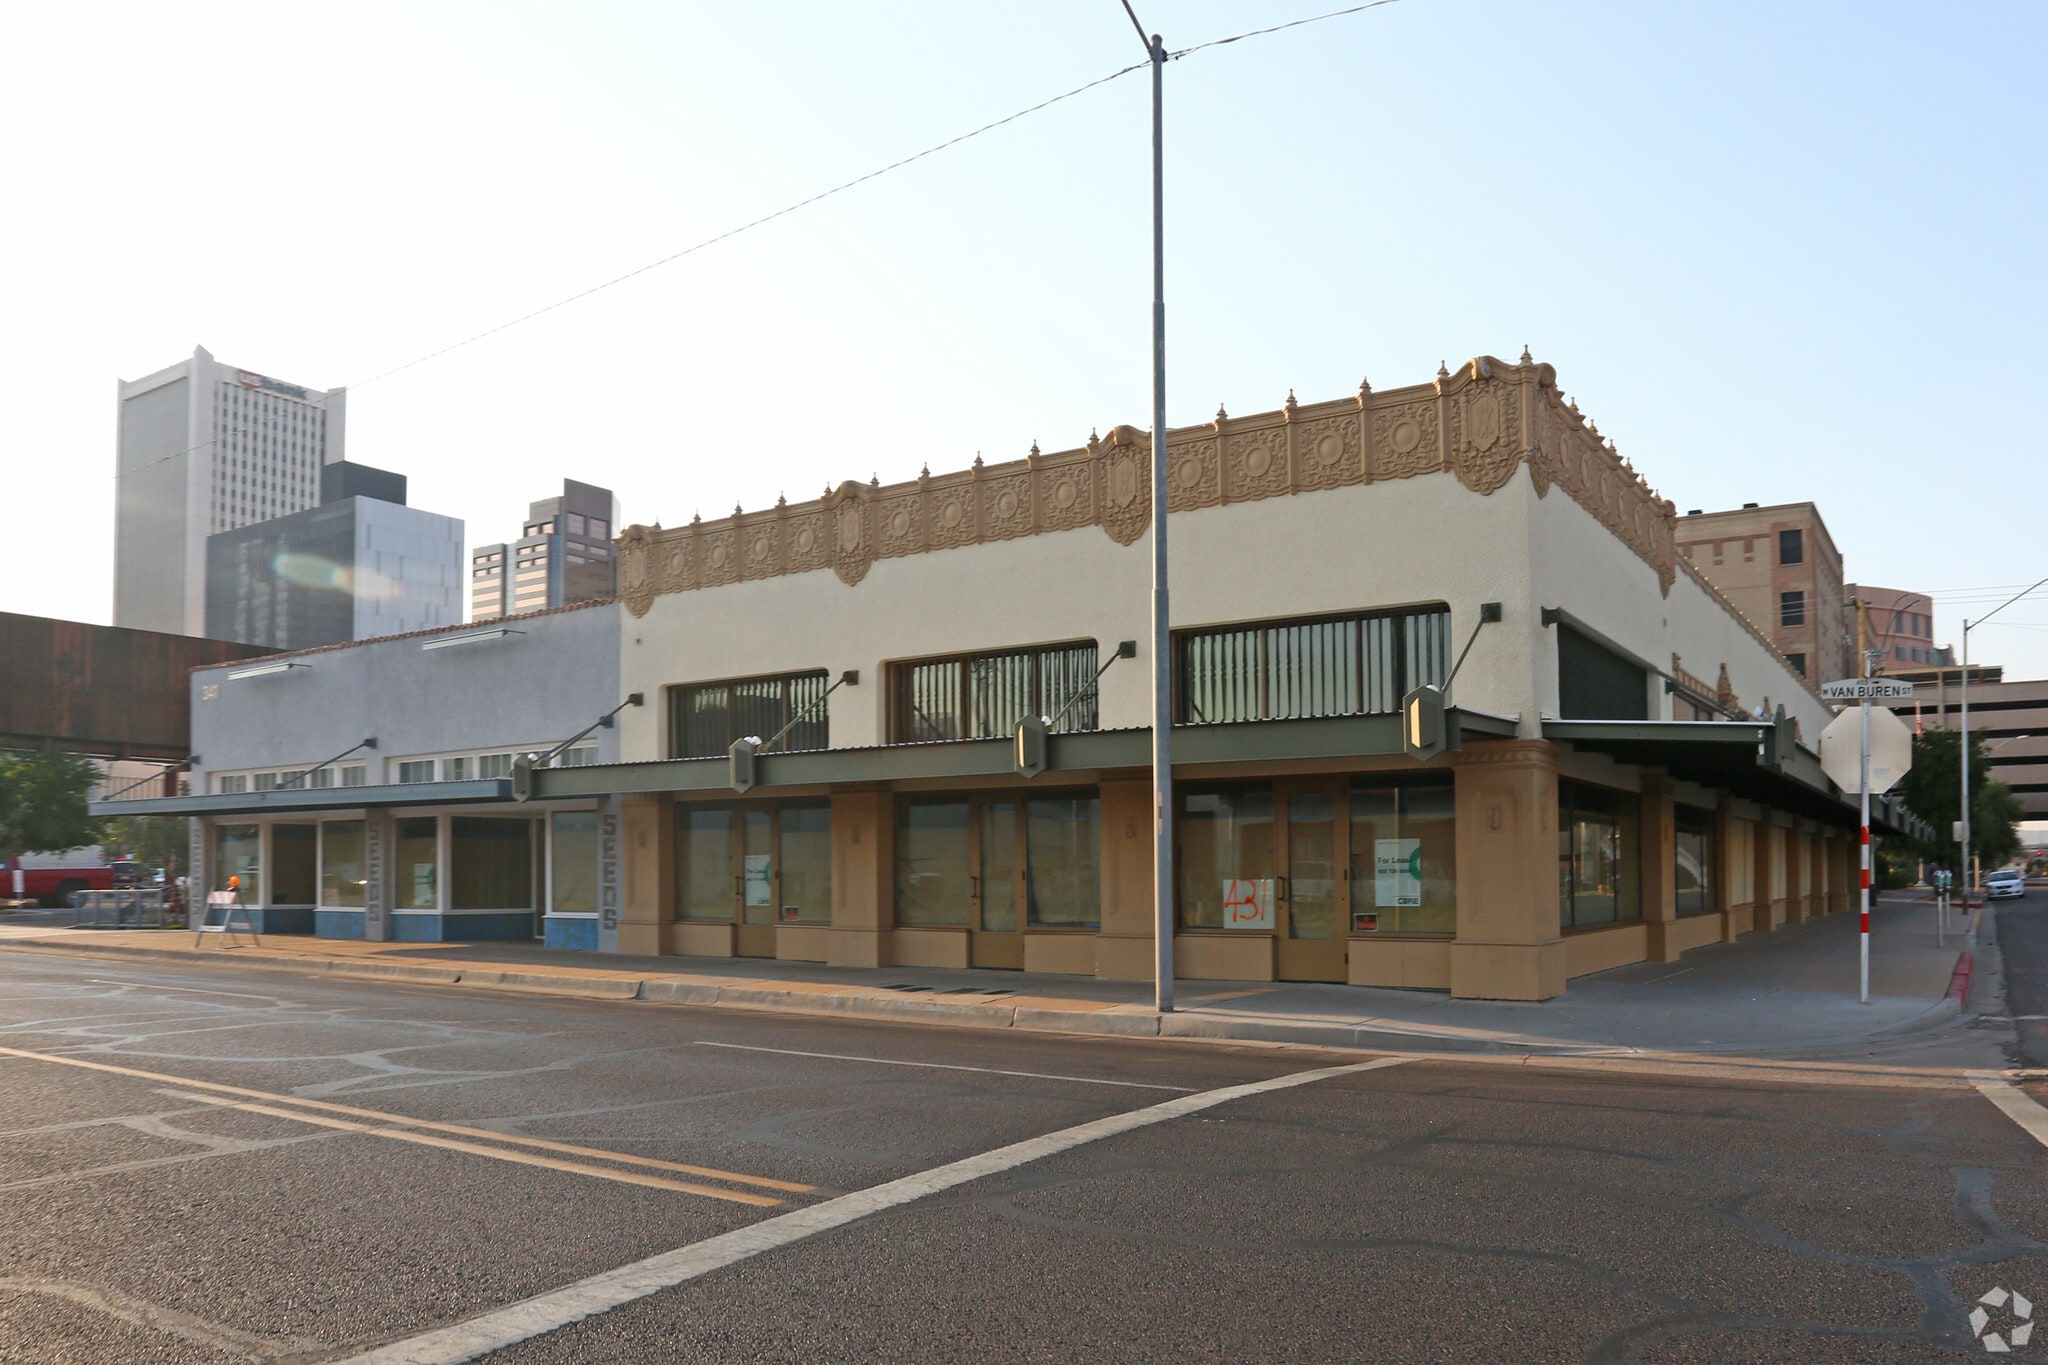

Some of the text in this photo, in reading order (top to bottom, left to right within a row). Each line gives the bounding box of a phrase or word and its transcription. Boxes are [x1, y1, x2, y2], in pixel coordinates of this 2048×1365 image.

[1830, 687, 1854, 697] VAN
[1858, 686, 1900, 697] BUREN
[603, 813, 617, 931] SEEDS
[1224, 878, 1267, 922] 431
